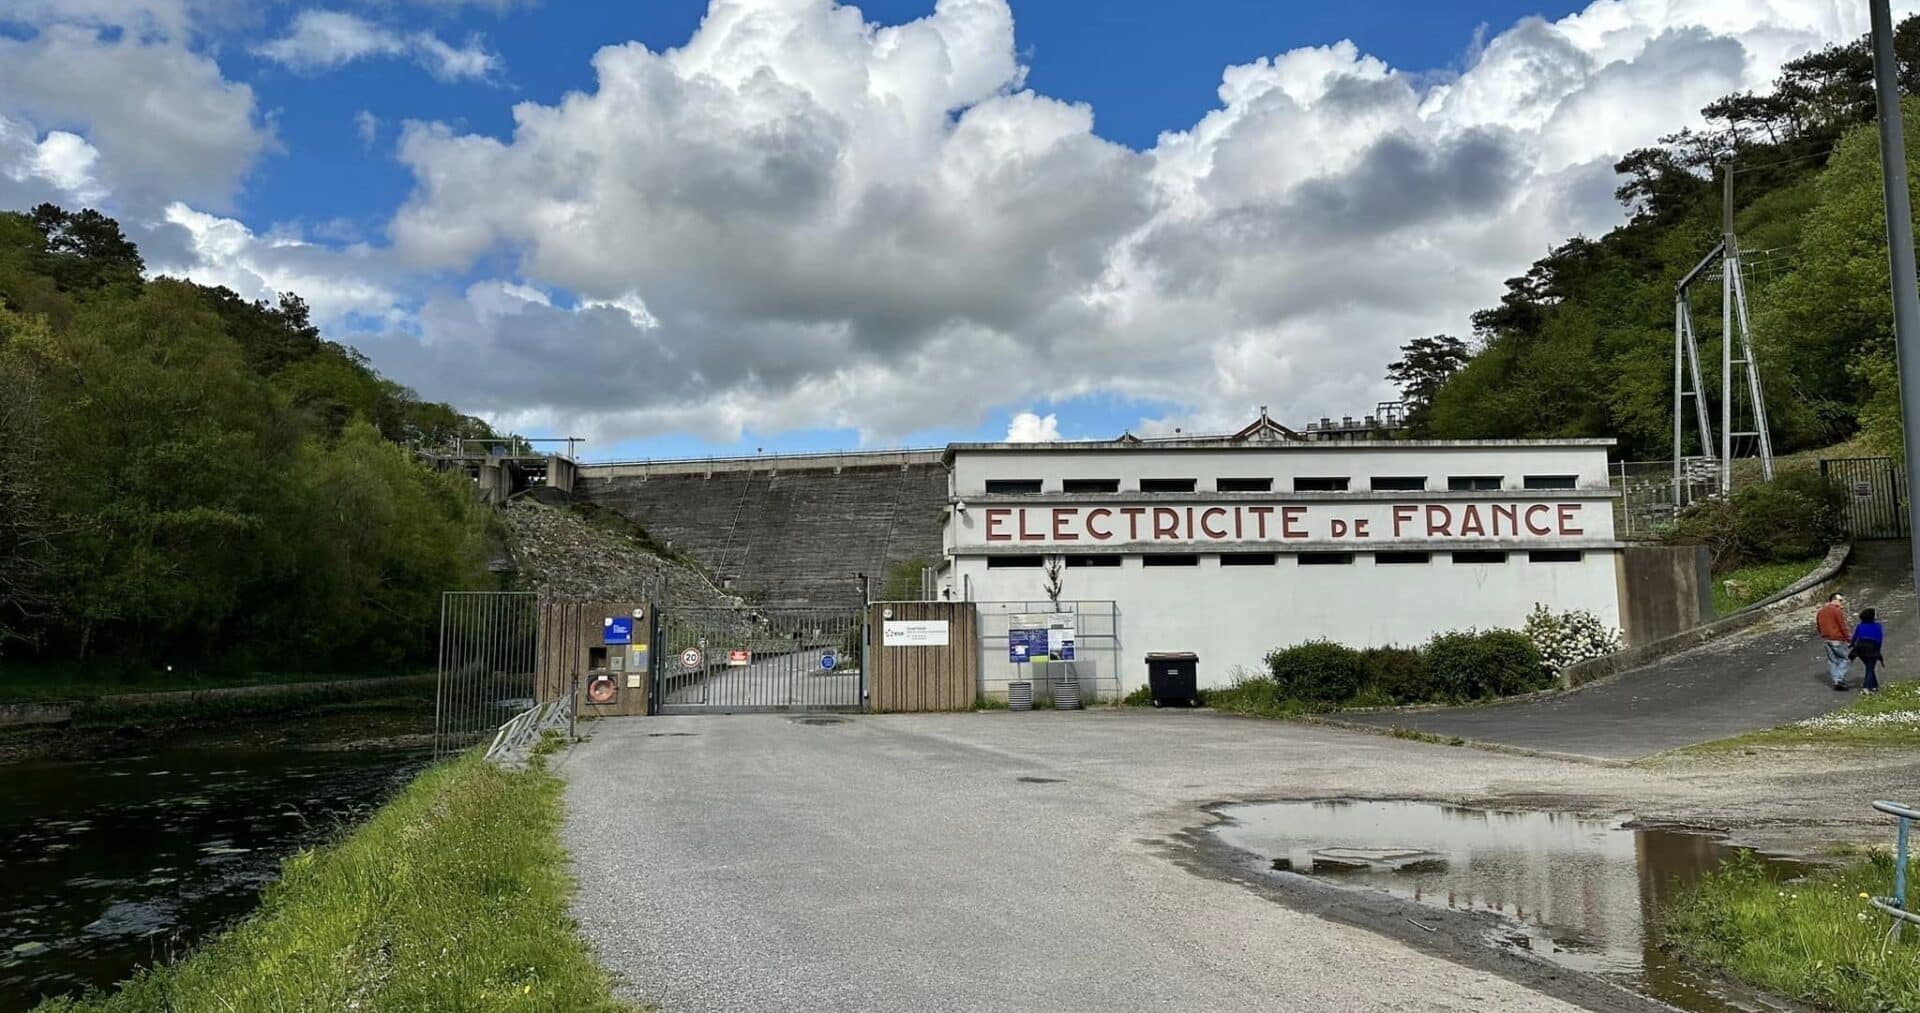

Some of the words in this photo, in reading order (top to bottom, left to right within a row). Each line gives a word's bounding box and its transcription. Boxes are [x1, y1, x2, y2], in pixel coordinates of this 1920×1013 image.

[986, 507, 1309, 540] ELECTRICITE
[1331, 519, 1369, 538] DE
[1393, 504, 1583, 537] FRANCE
[686, 653, 697, 662] 20
